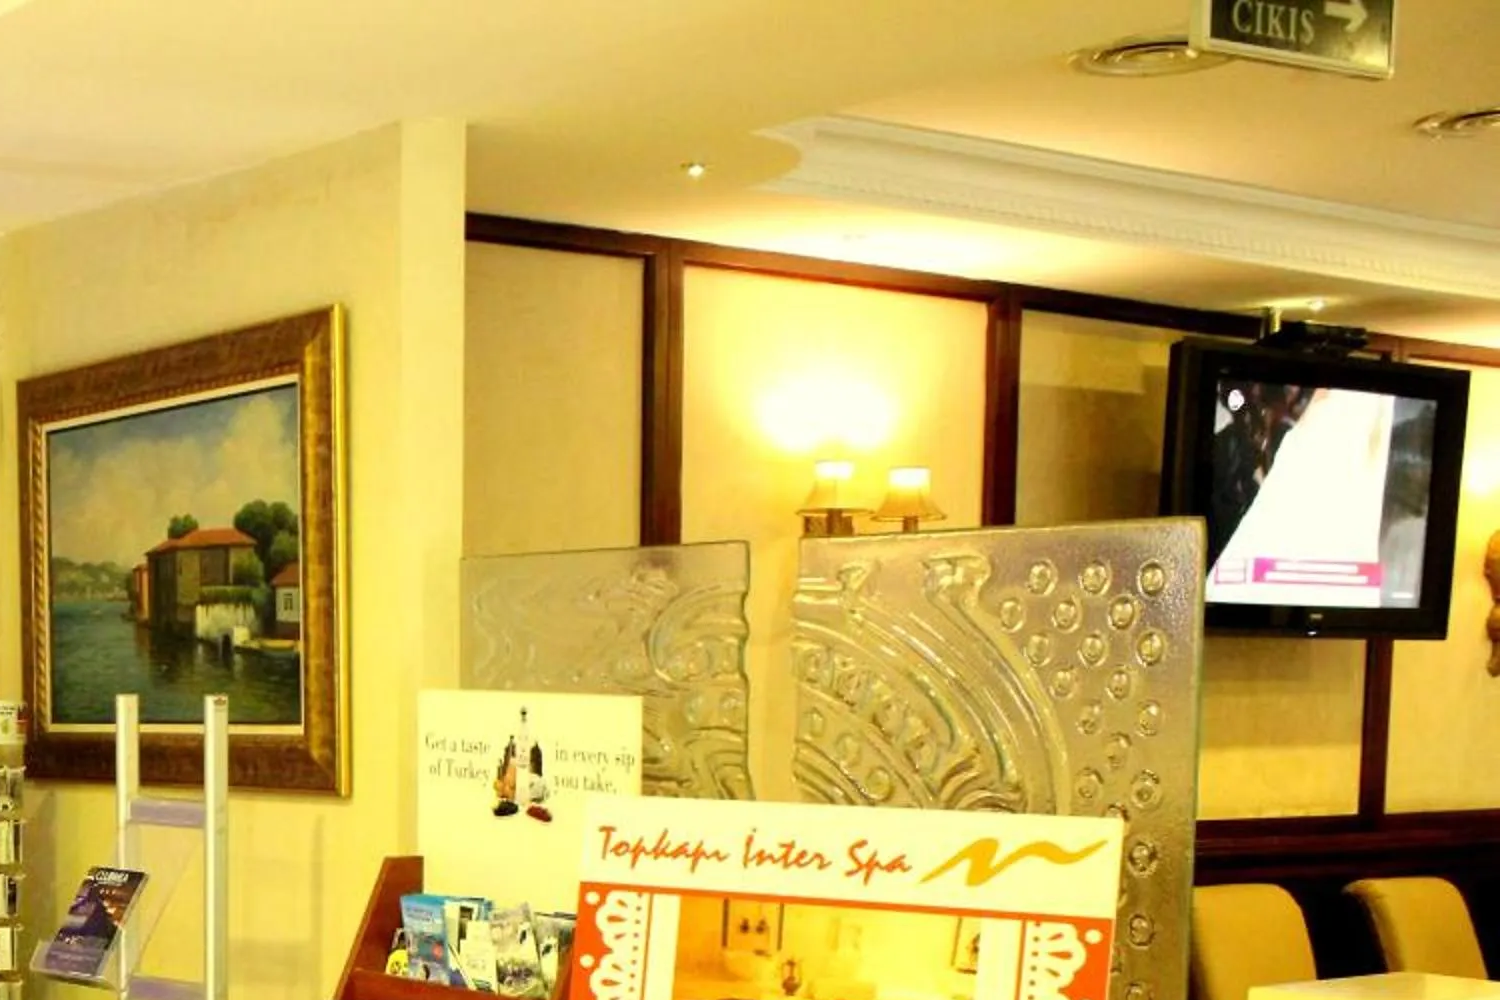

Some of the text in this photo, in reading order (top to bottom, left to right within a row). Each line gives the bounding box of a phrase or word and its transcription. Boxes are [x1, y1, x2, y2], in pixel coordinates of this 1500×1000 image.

[425, 733, 491, 755] Get a taste
[554, 742, 636, 774] in every sip
[429, 758, 491, 788] of Turkey
[553, 774, 579, 795] you
[844, 838, 913, 886] Spa
